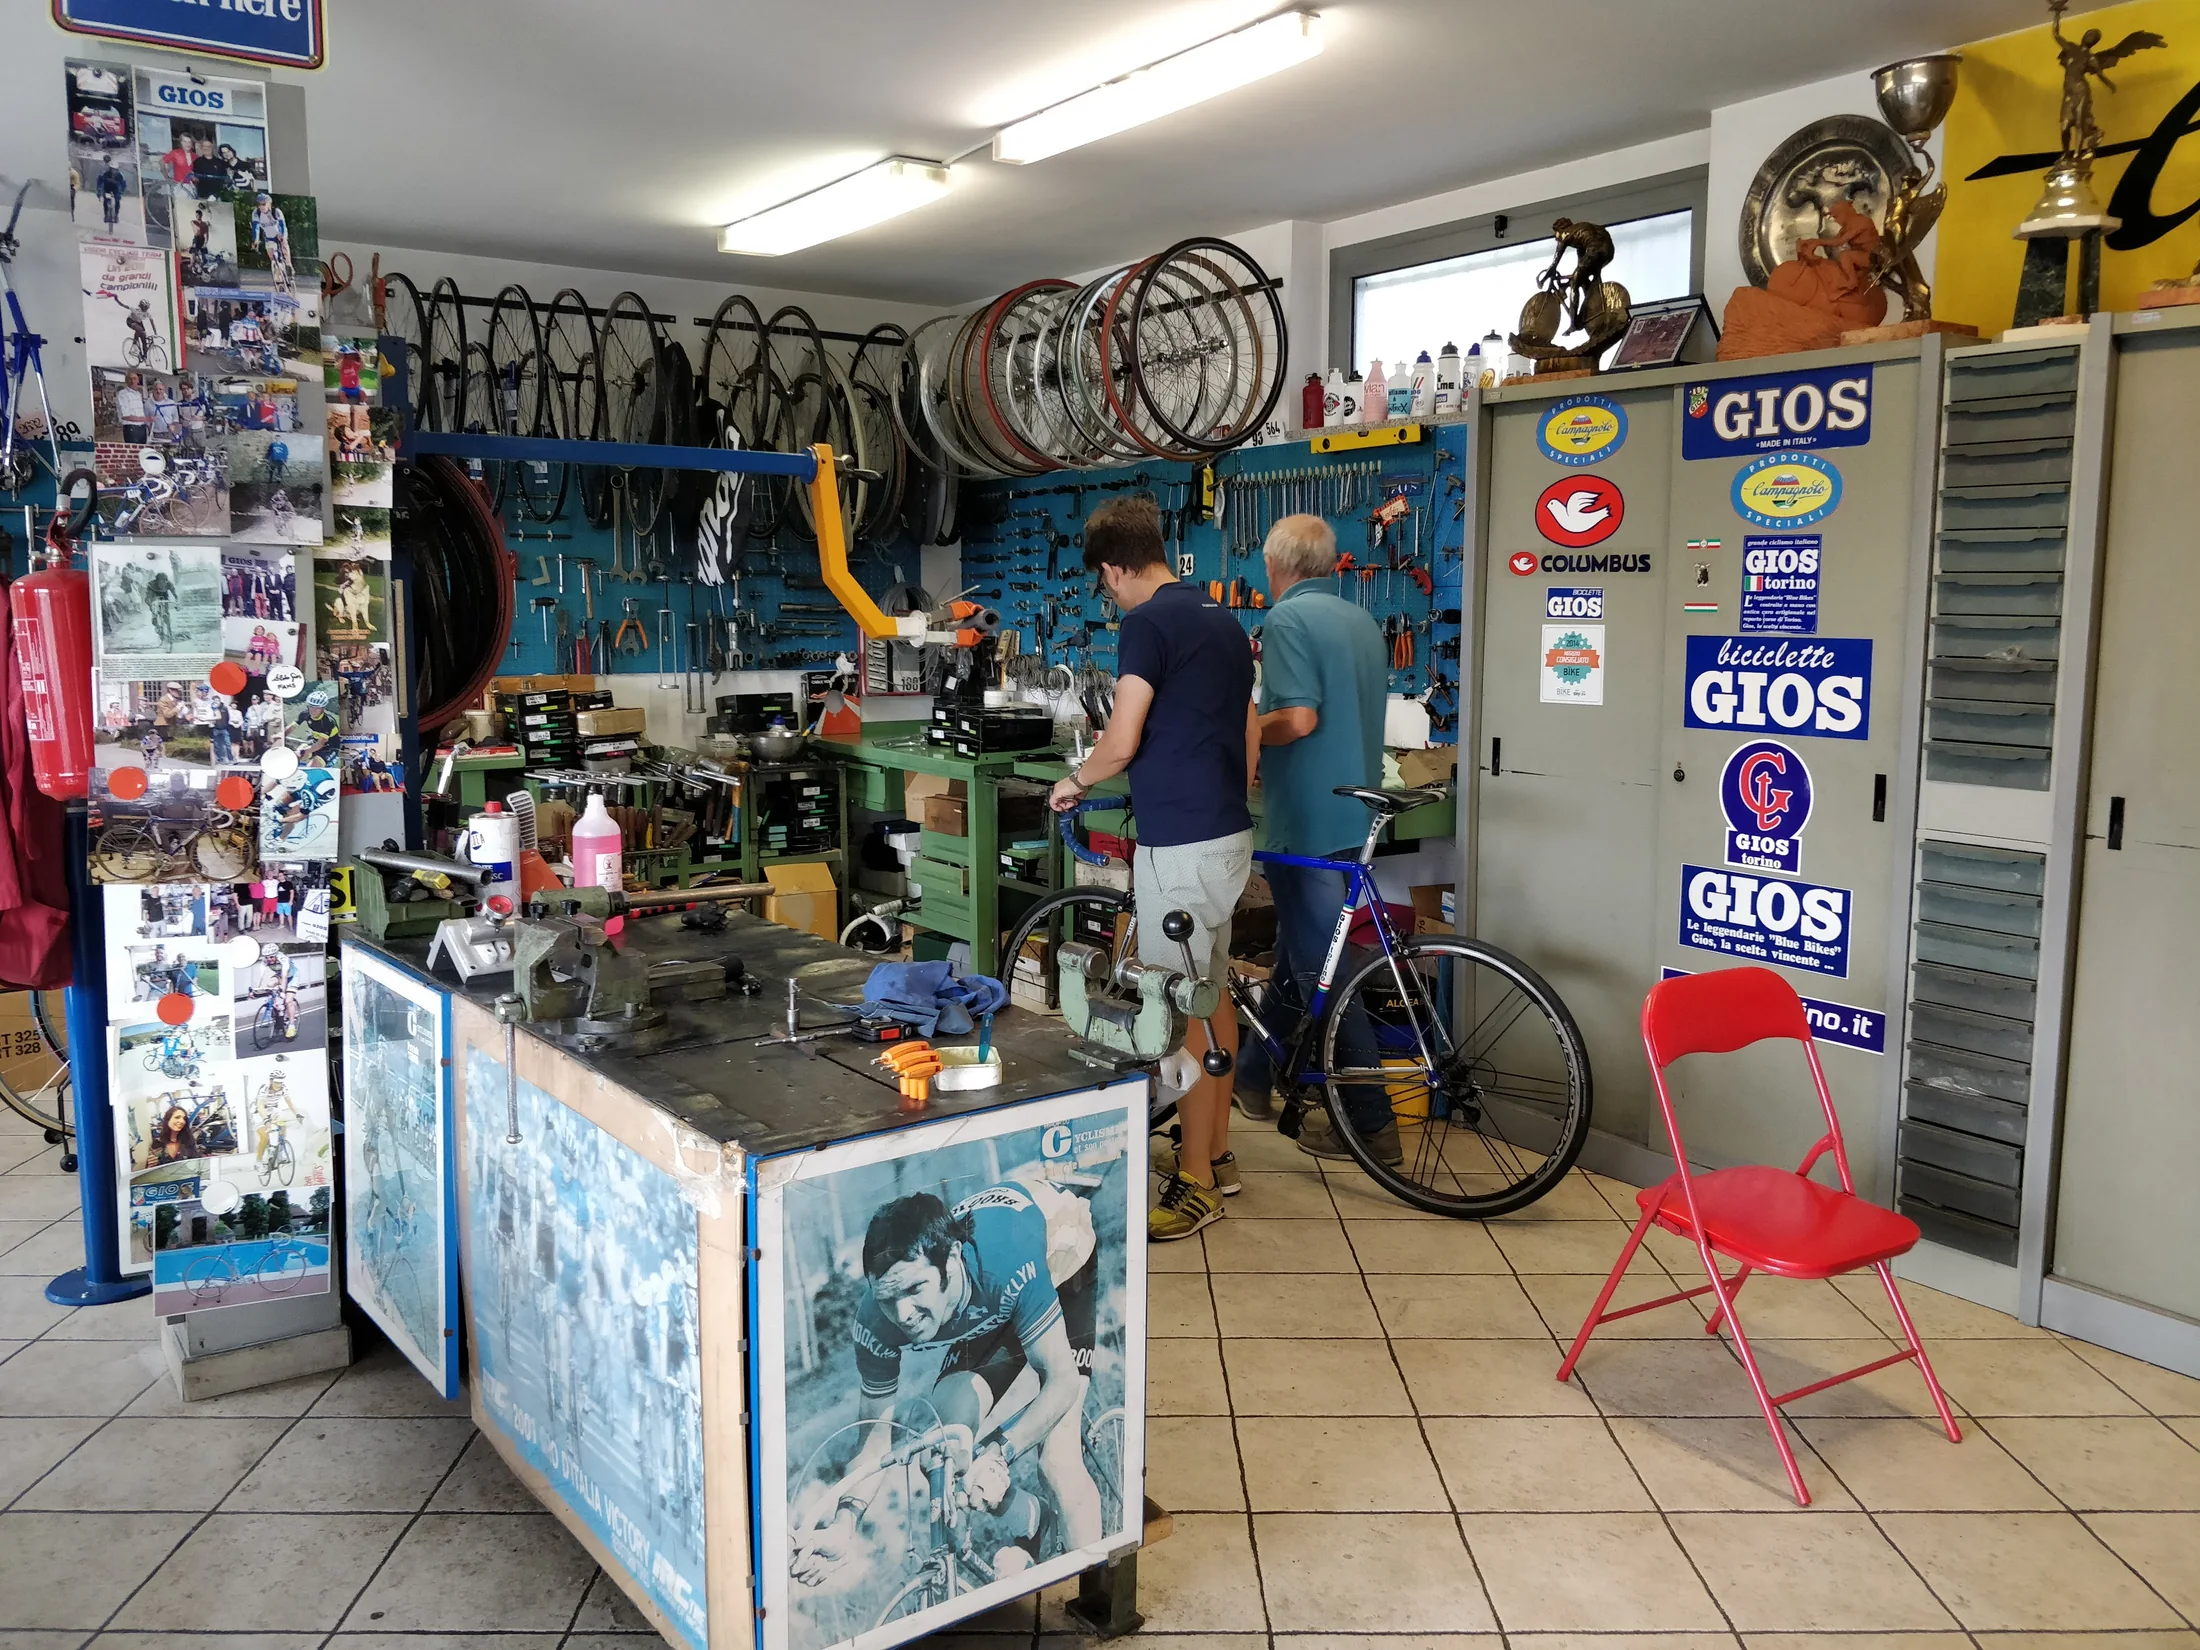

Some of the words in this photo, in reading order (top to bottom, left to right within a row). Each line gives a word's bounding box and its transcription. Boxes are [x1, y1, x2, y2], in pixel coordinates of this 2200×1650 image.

[158, 85, 224, 109] GIOS
[119, 272, 151, 282] grandi
[1551, 395, 1612, 414] PRODOTTI
[1714, 378, 1868, 441] GIOS
[1556, 420, 1614, 438] Campagnolo
[1783, 438, 1791, 446] IN
[1549, 446, 1611, 464] SPECIALI
[1749, 454, 1826, 473] PRODOTTI
[1753, 480, 1826, 504] Campagnolo
[1746, 509, 1824, 527] SPECIALI
[228, 557, 252, 565] GIOS
[1541, 554, 1651, 573] COLUMBUS
[1745, 549, 1819, 574] GIOS
[1764, 575, 1816, 590] torino
[1548, 597, 1602, 618] GIOS
[1566, 640, 1580, 648] 2014
[1718, 638, 1835, 669] biciclette
[1690, 670, 1863, 732] GIOS
[1735, 833, 1790, 856] GIOS
[1741, 852, 1782, 869] torino
[1688, 872, 1843, 942] GIOS
[1332, 913, 1346, 943] GIOS
[1687, 919, 1699, 930] Le
[1703, 922, 1765, 943] leggendarie
[1691, 933, 1717, 949] Gios,
[1721, 938, 1731, 950] la
[1735, 943, 1767, 957] scelta
[1771, 950, 1820, 967] vincente
[0, 1033, 11, 1046] T
[0, 1046, 12, 1058] T
[15, 1042, 41, 1056] 328
[603, 1495, 650, 1567] VICTORY
